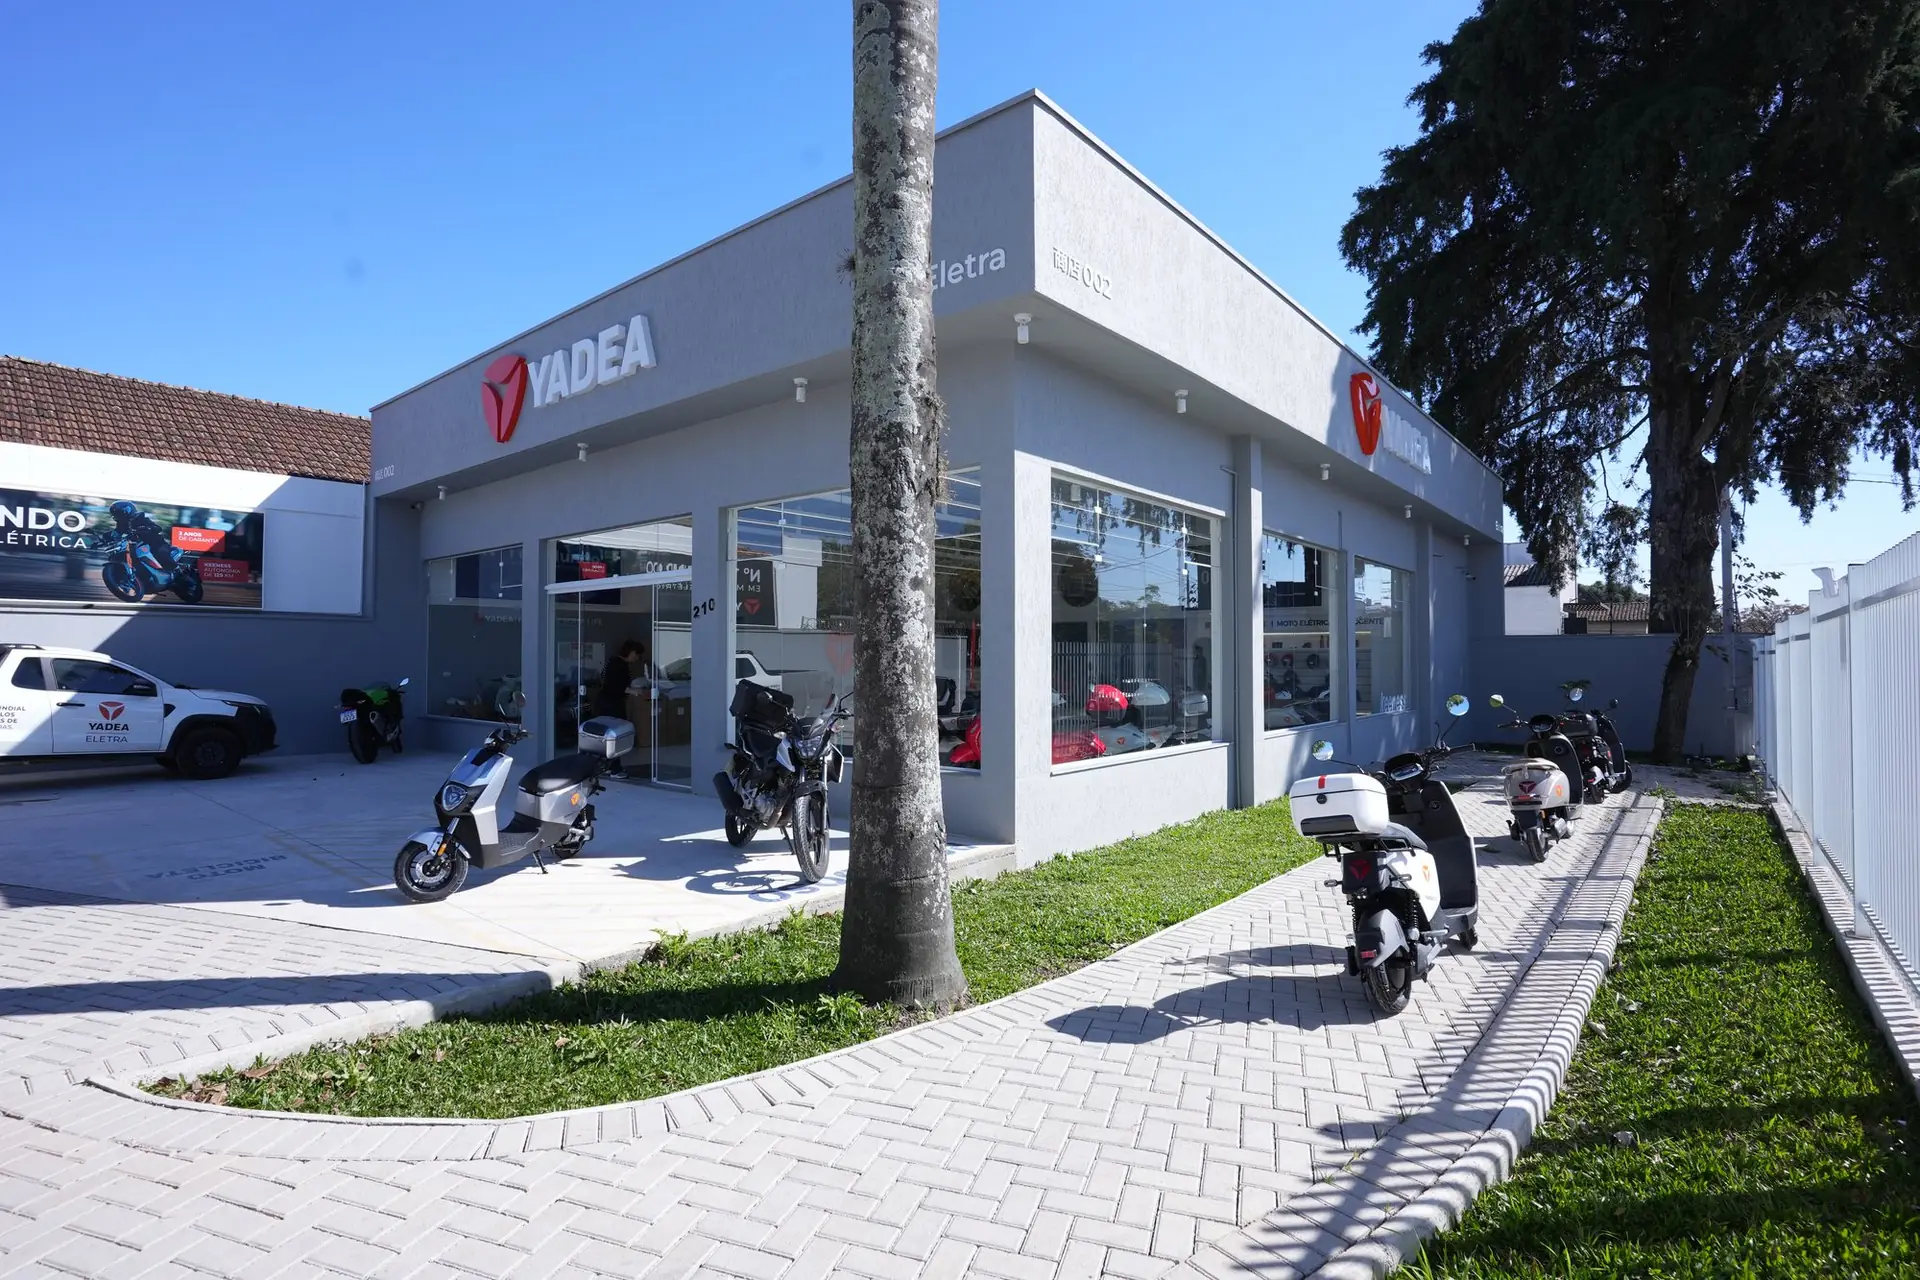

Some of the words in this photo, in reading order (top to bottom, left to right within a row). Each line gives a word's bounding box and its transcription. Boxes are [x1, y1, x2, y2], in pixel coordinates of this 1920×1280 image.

[527, 314, 657, 408] YADEA
[0, 504, 86, 532] NDO
[693, 597, 716, 619] 210
[88, 722, 130, 732] YADEA
[85, 735, 129, 743] ELETRA
